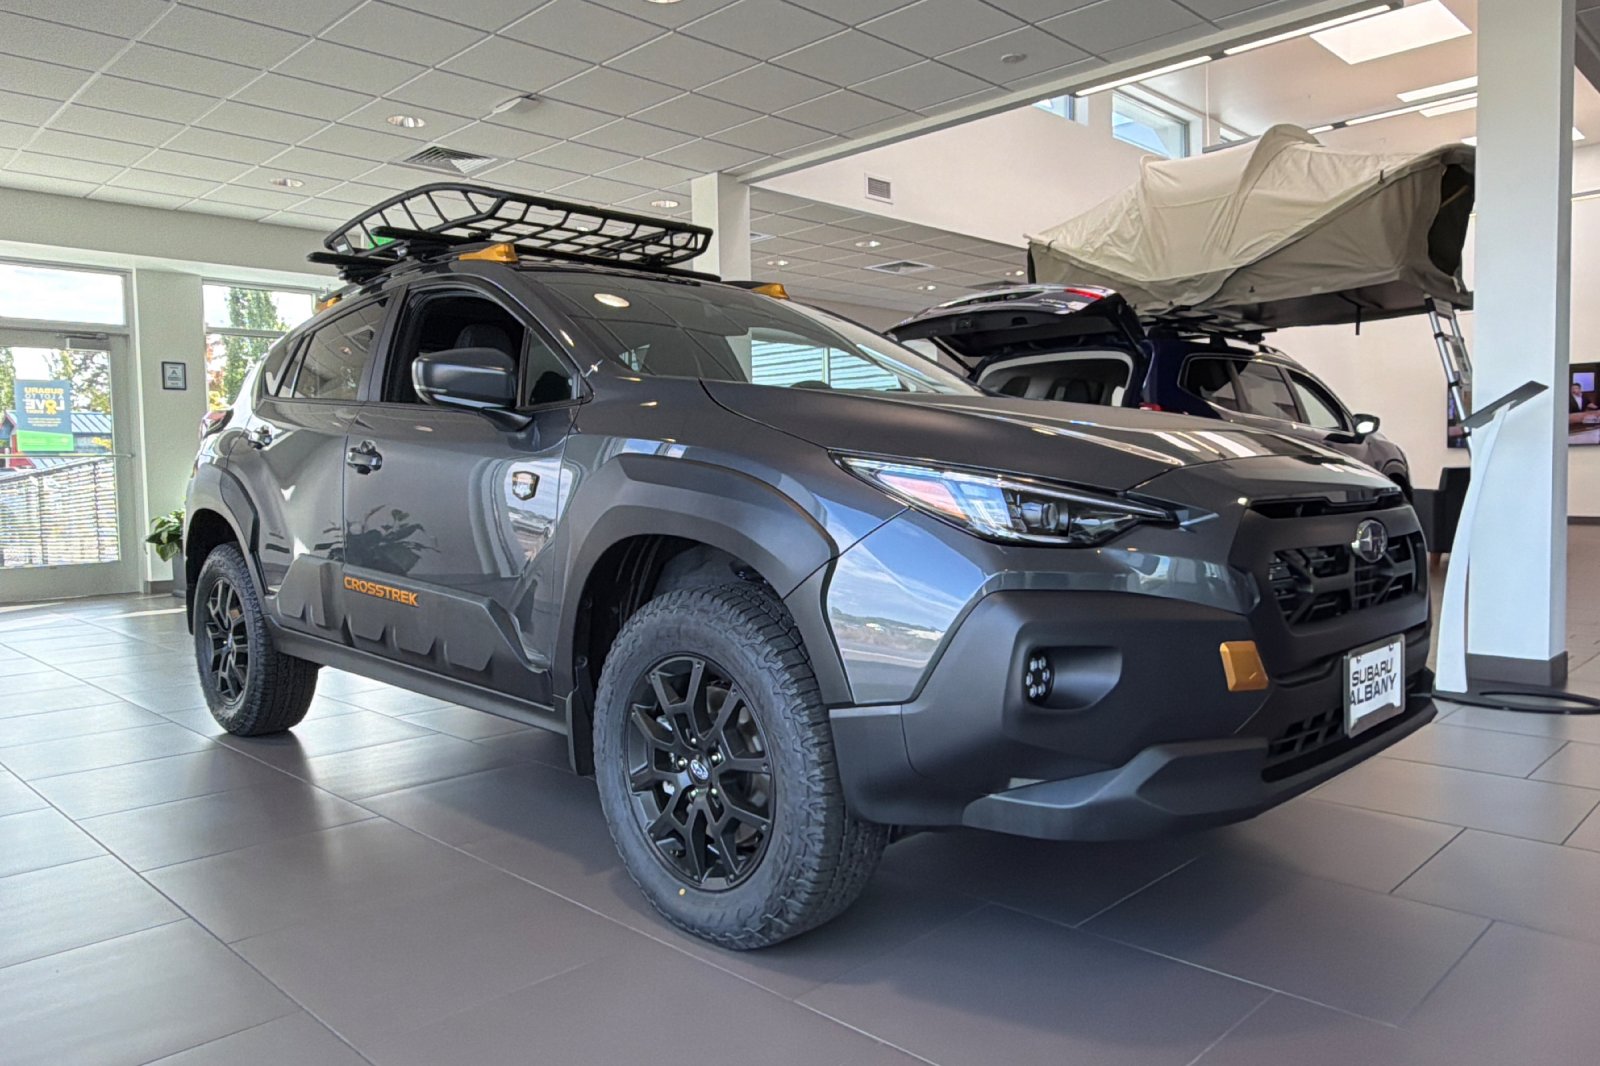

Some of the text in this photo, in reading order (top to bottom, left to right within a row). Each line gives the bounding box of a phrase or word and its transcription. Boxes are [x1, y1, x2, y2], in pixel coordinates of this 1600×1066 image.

[343, 576, 420, 608] CROSSTREK
[1352, 657, 1393, 687] SUBARU
[1349, 673, 1397, 705] ALBANY
